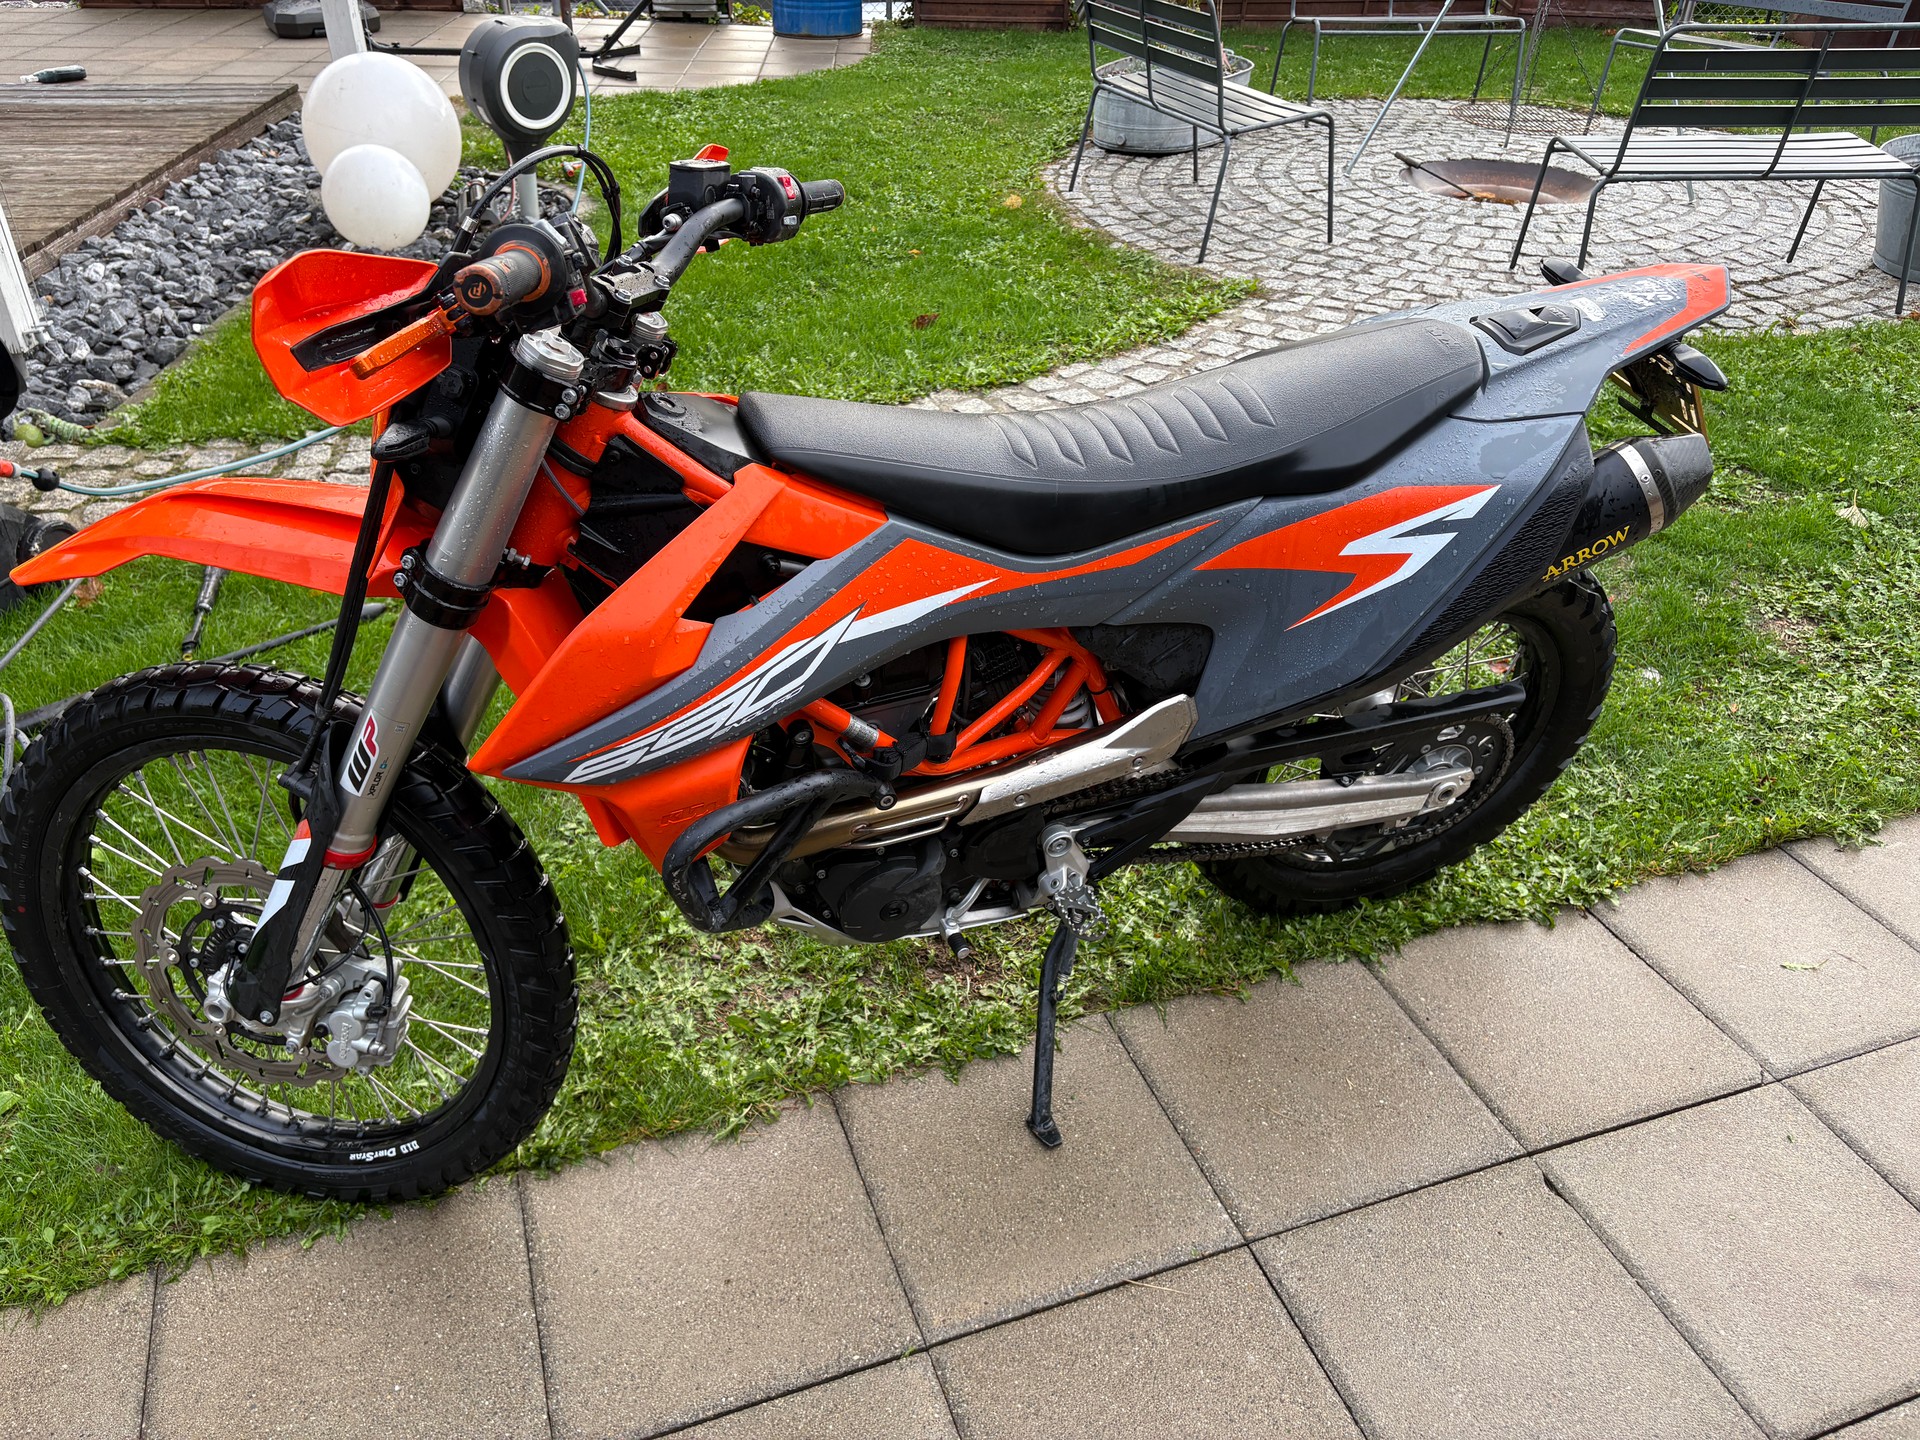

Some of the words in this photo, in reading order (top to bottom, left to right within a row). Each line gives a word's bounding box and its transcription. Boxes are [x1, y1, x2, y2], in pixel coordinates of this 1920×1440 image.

[1541, 525, 1630, 582] ARROW
[347, 714, 377, 794] WP
[367, 771, 385, 796] XPLOR
